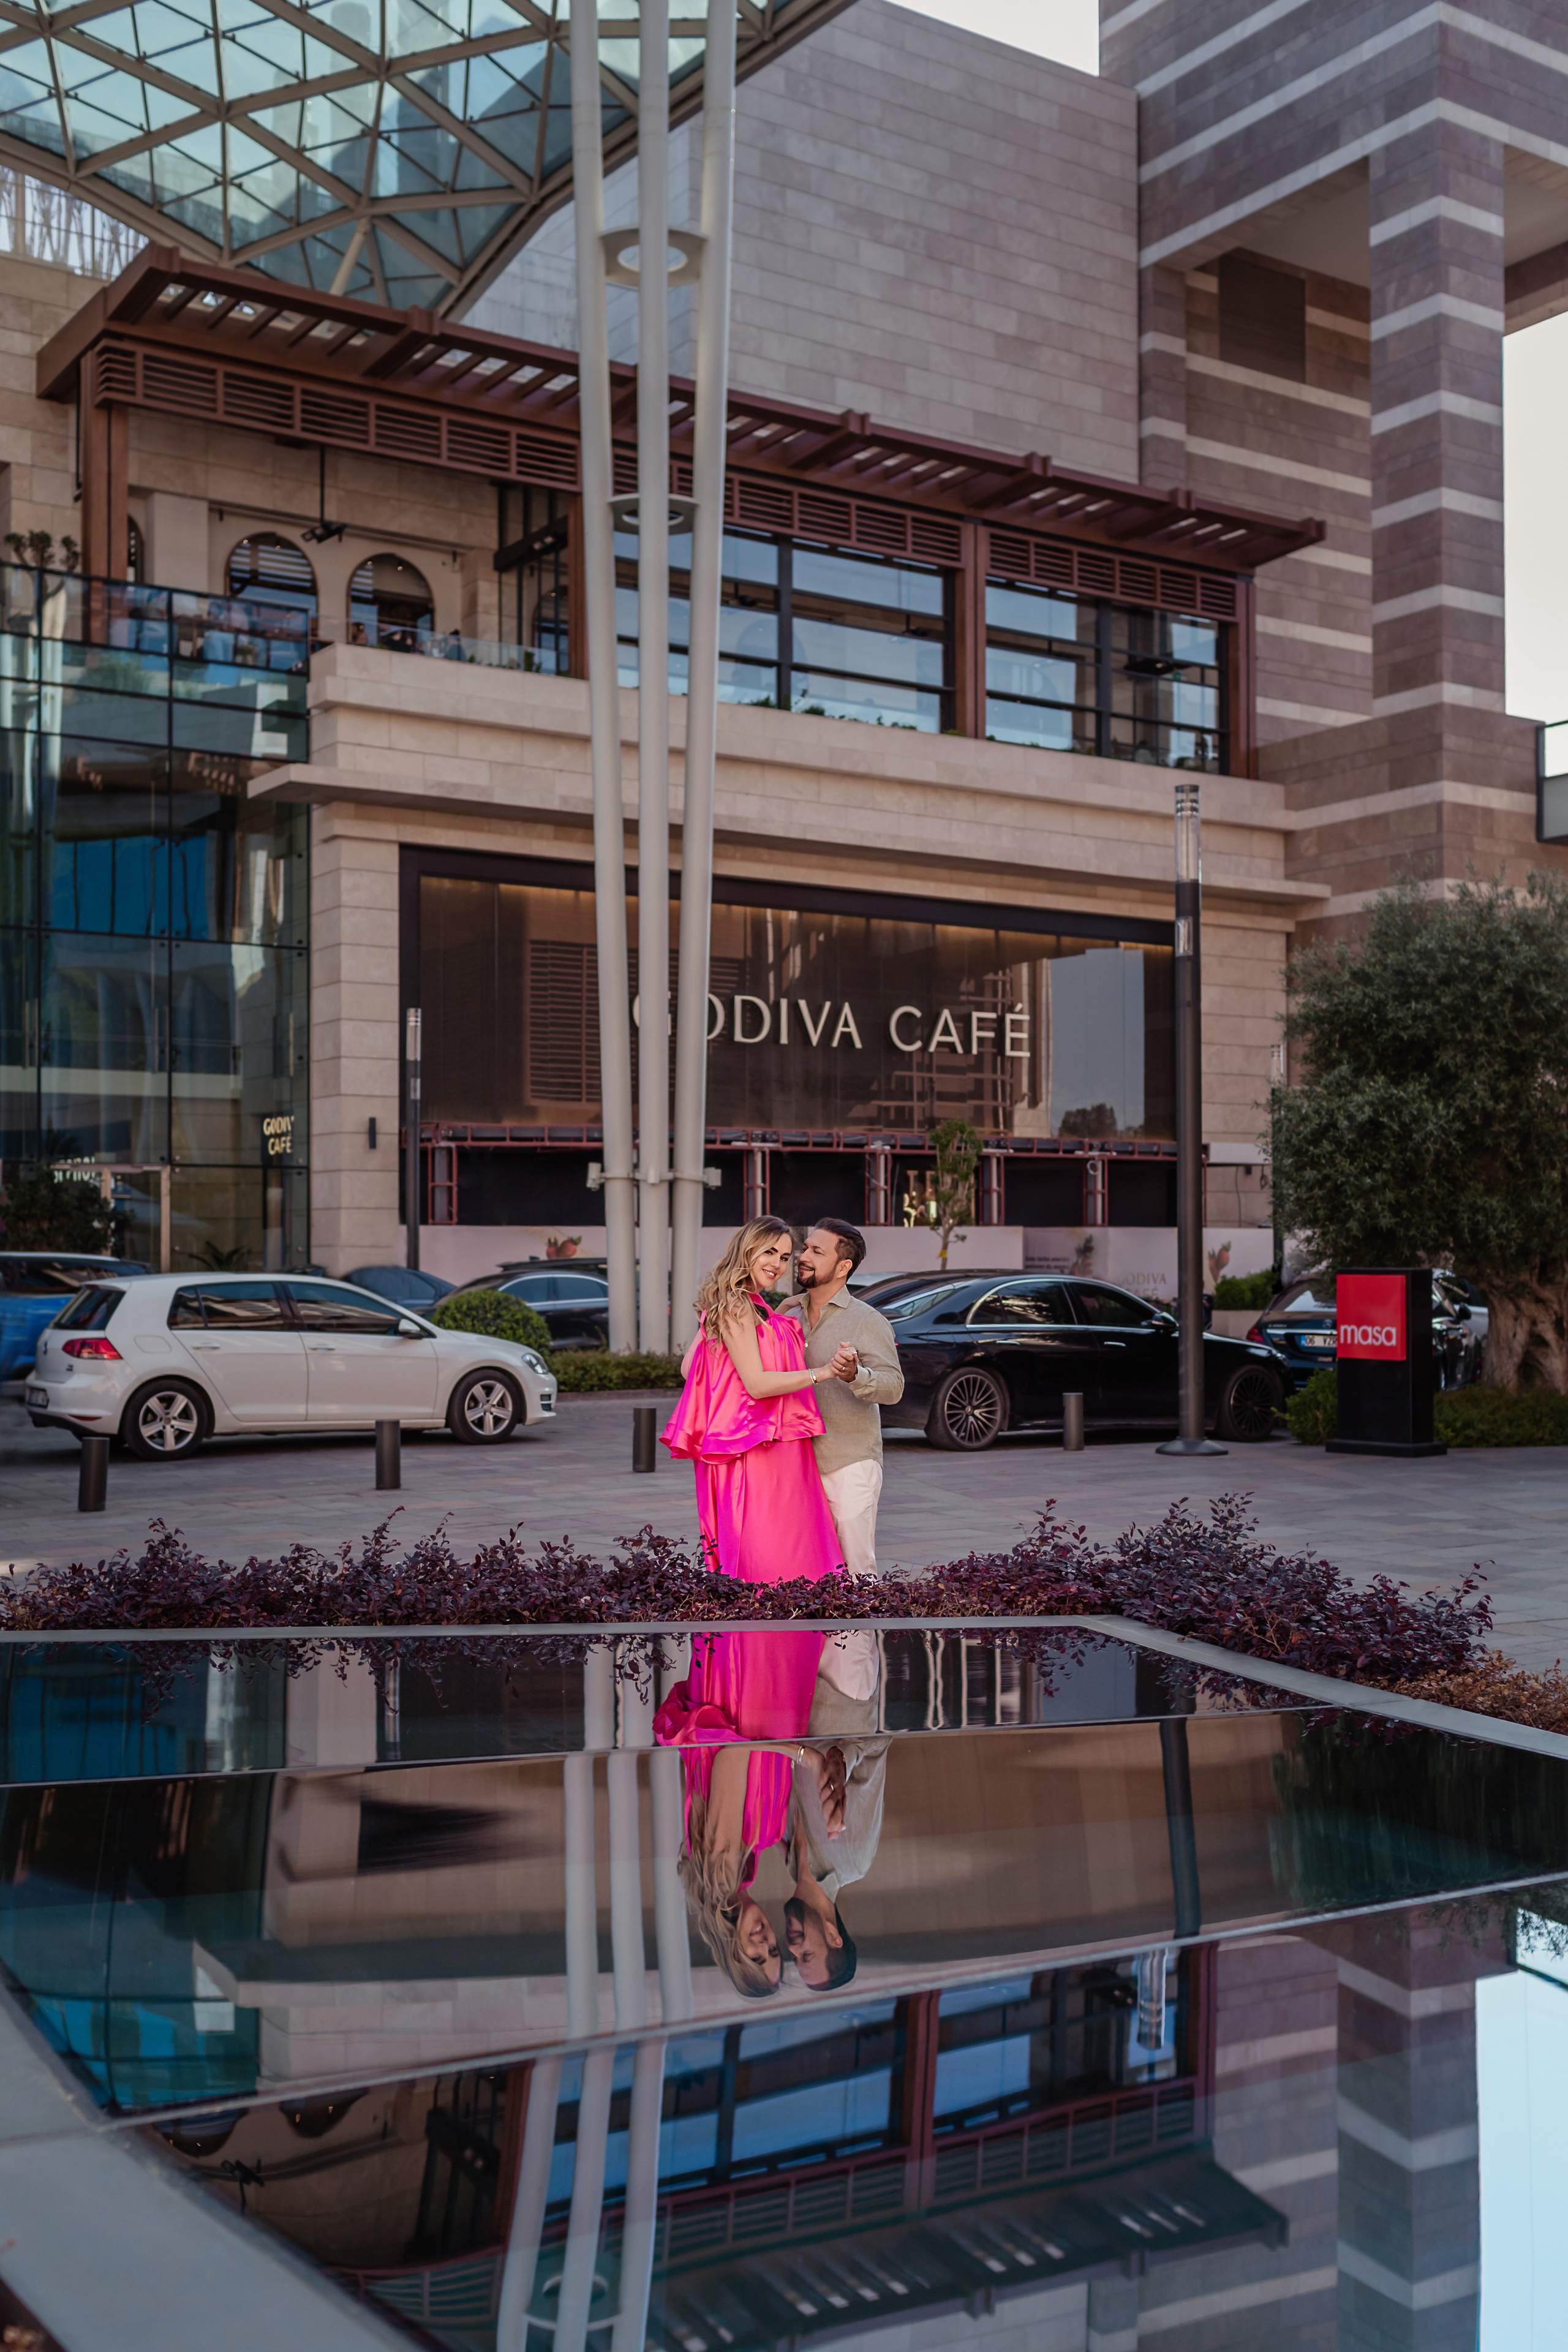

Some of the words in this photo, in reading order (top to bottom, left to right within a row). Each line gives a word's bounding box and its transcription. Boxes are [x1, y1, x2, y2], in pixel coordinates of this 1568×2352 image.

[633, 991, 862, 1049] DIVA
[889, 1003, 1030, 1057] CAFÉ
[268, 1134, 292, 1155] CAFÉ
[1305, 1336, 1316, 1345] 06
[1340, 1324, 1396, 1347] masa
